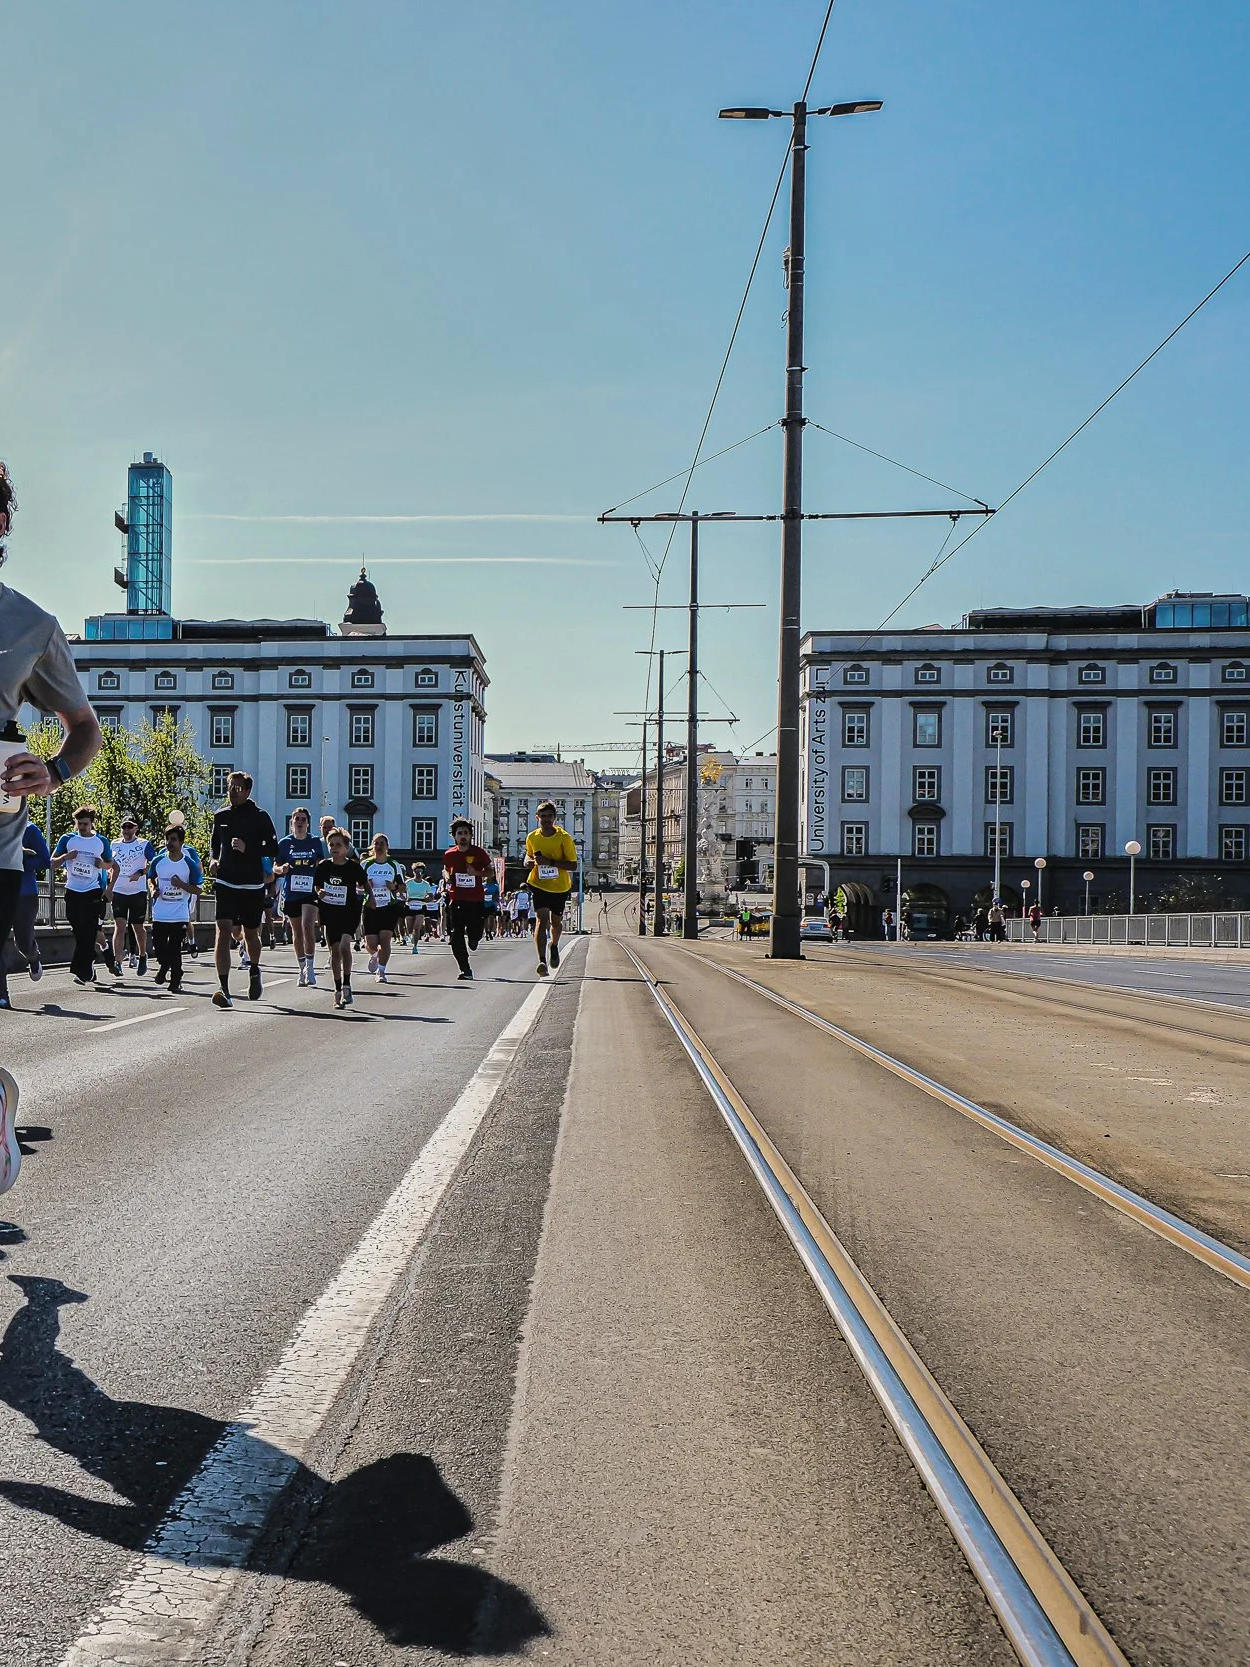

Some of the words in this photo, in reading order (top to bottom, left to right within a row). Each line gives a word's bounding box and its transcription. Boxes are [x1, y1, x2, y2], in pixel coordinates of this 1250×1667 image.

[452, 671, 467, 807] Kustuniversität
[812, 710, 826, 745] Arts
[812, 749, 826, 764] of
[811, 768, 828, 851] University
[73, 866, 91, 875] TOBIAS
[294, 879, 309, 887] ALMA
